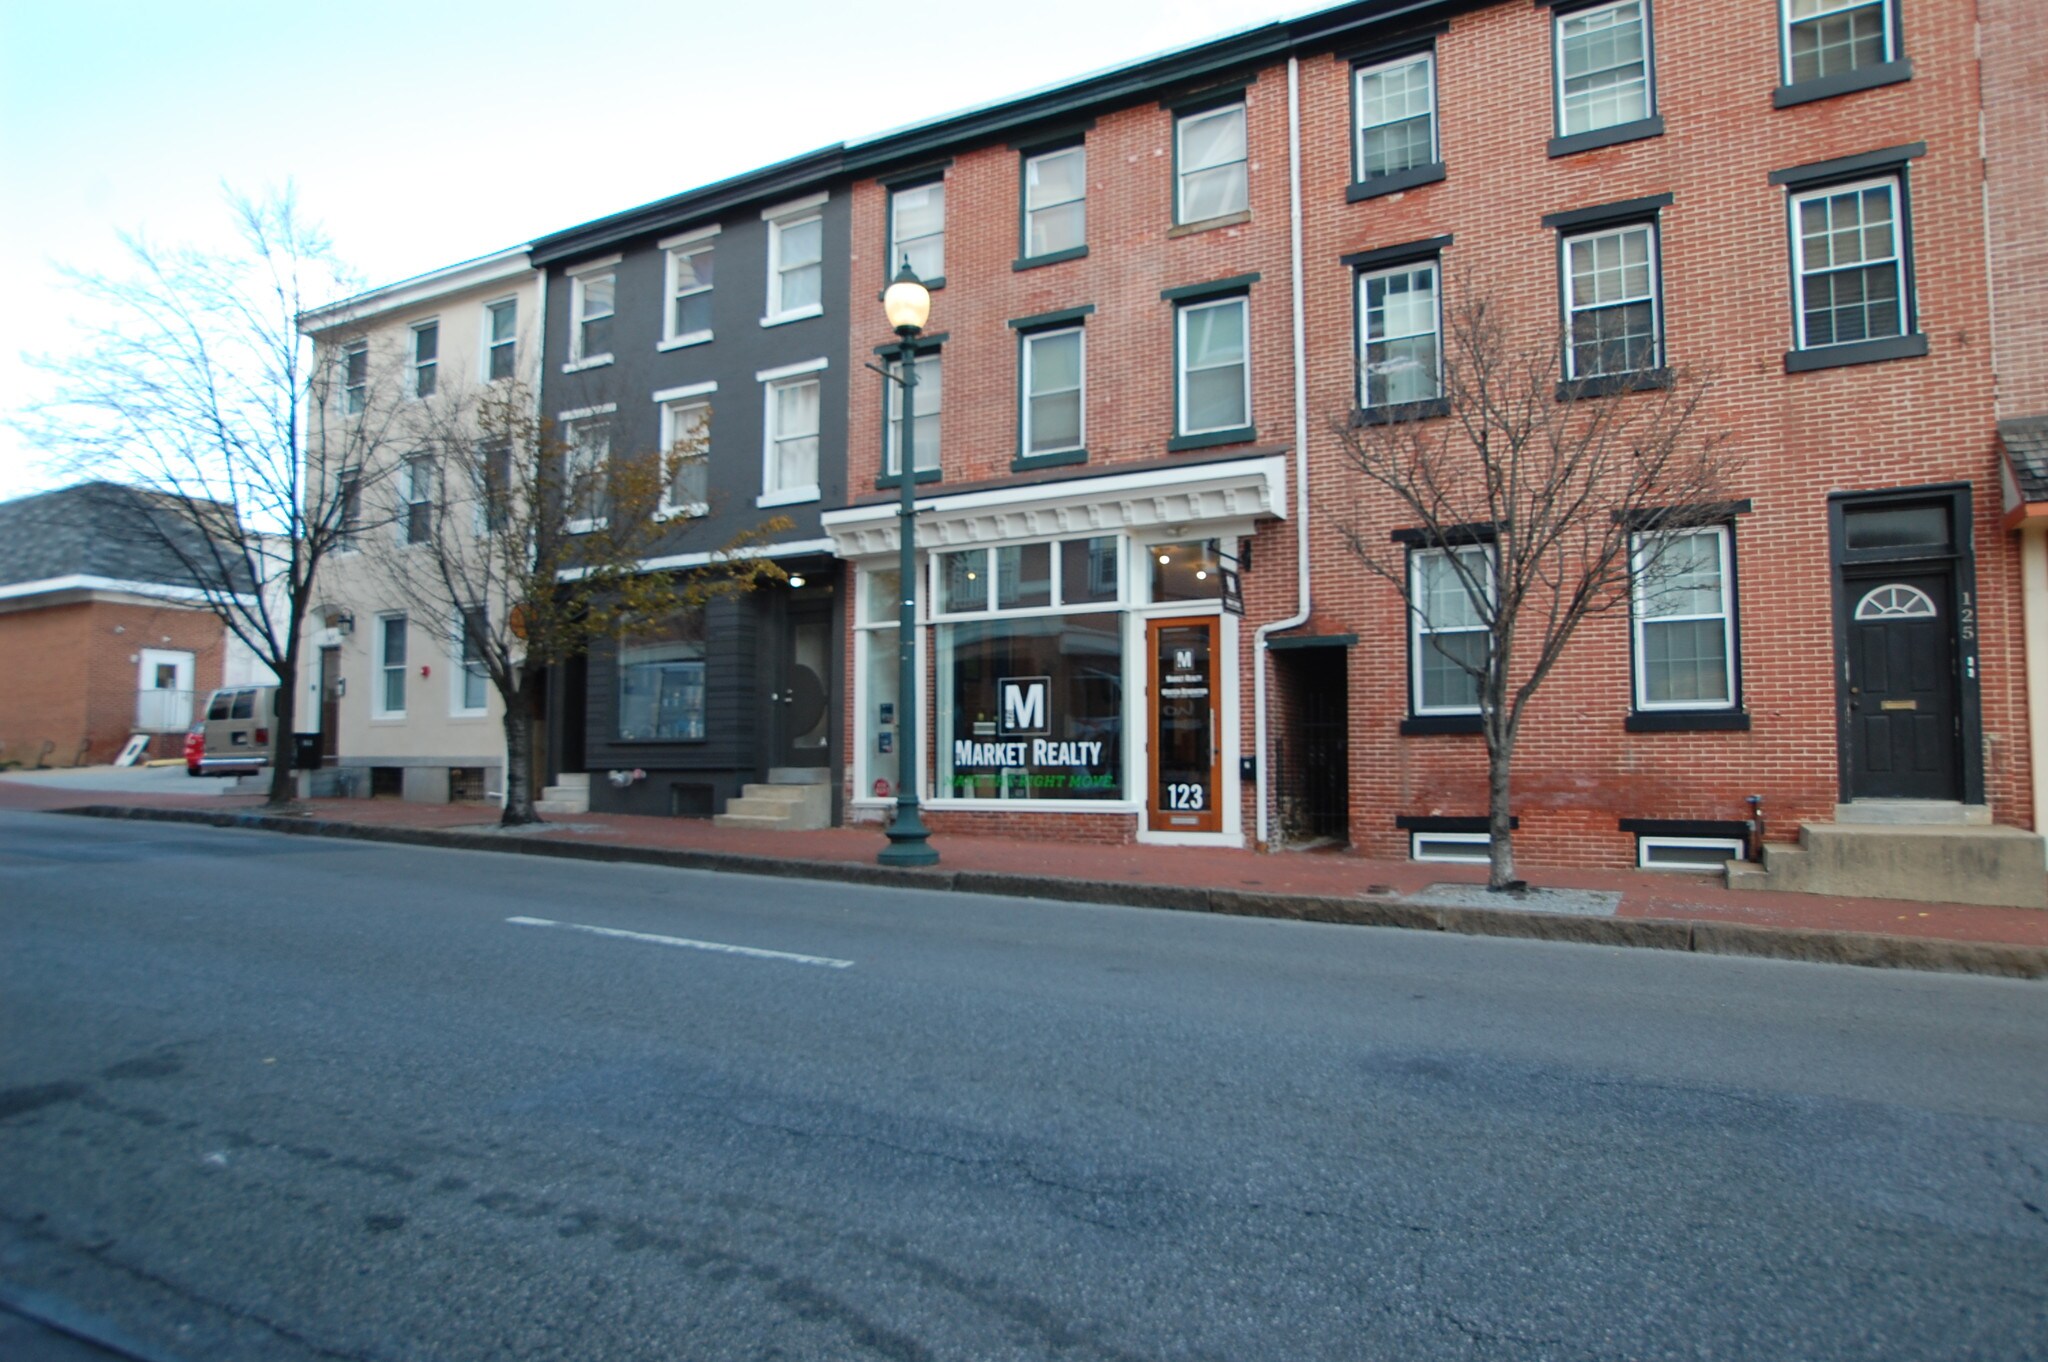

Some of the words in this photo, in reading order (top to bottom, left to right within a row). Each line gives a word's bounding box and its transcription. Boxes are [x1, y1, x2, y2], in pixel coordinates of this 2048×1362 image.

[1961, 591, 1974, 640] 125
[1177, 651, 1192, 668] M
[1005, 683, 1044, 729] M
[955, 740, 1028, 766] MARKET
[1033, 738, 1102, 766] REALTY
[1168, 783, 1203, 809] 123
